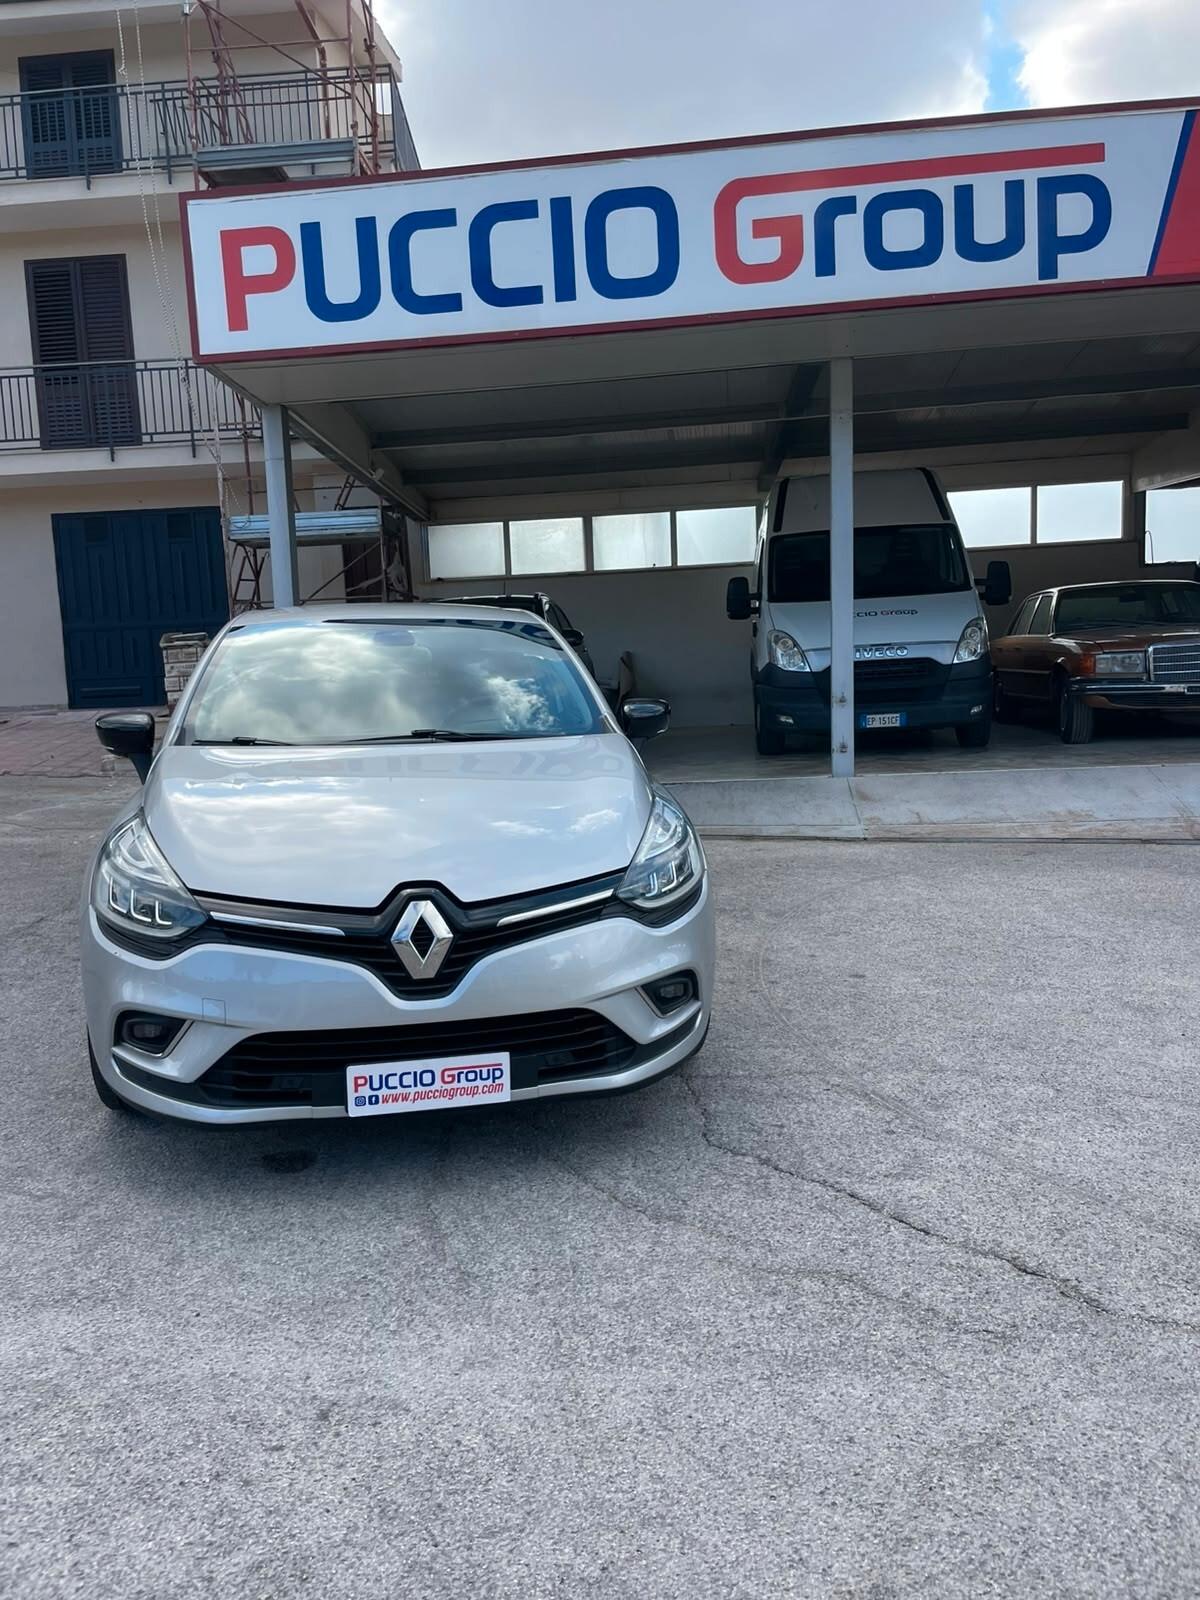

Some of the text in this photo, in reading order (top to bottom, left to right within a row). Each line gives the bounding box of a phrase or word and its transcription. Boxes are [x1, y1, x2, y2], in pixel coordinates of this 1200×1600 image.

[220, 142, 1111, 332] PUCCIO Group
[853, 610, 878, 618] CIO
[855, 646, 908, 659] IVECO
[354, 1063, 504, 1093] PUCCIO Group
[381, 1083, 504, 1104] www.pucciogroup.com
